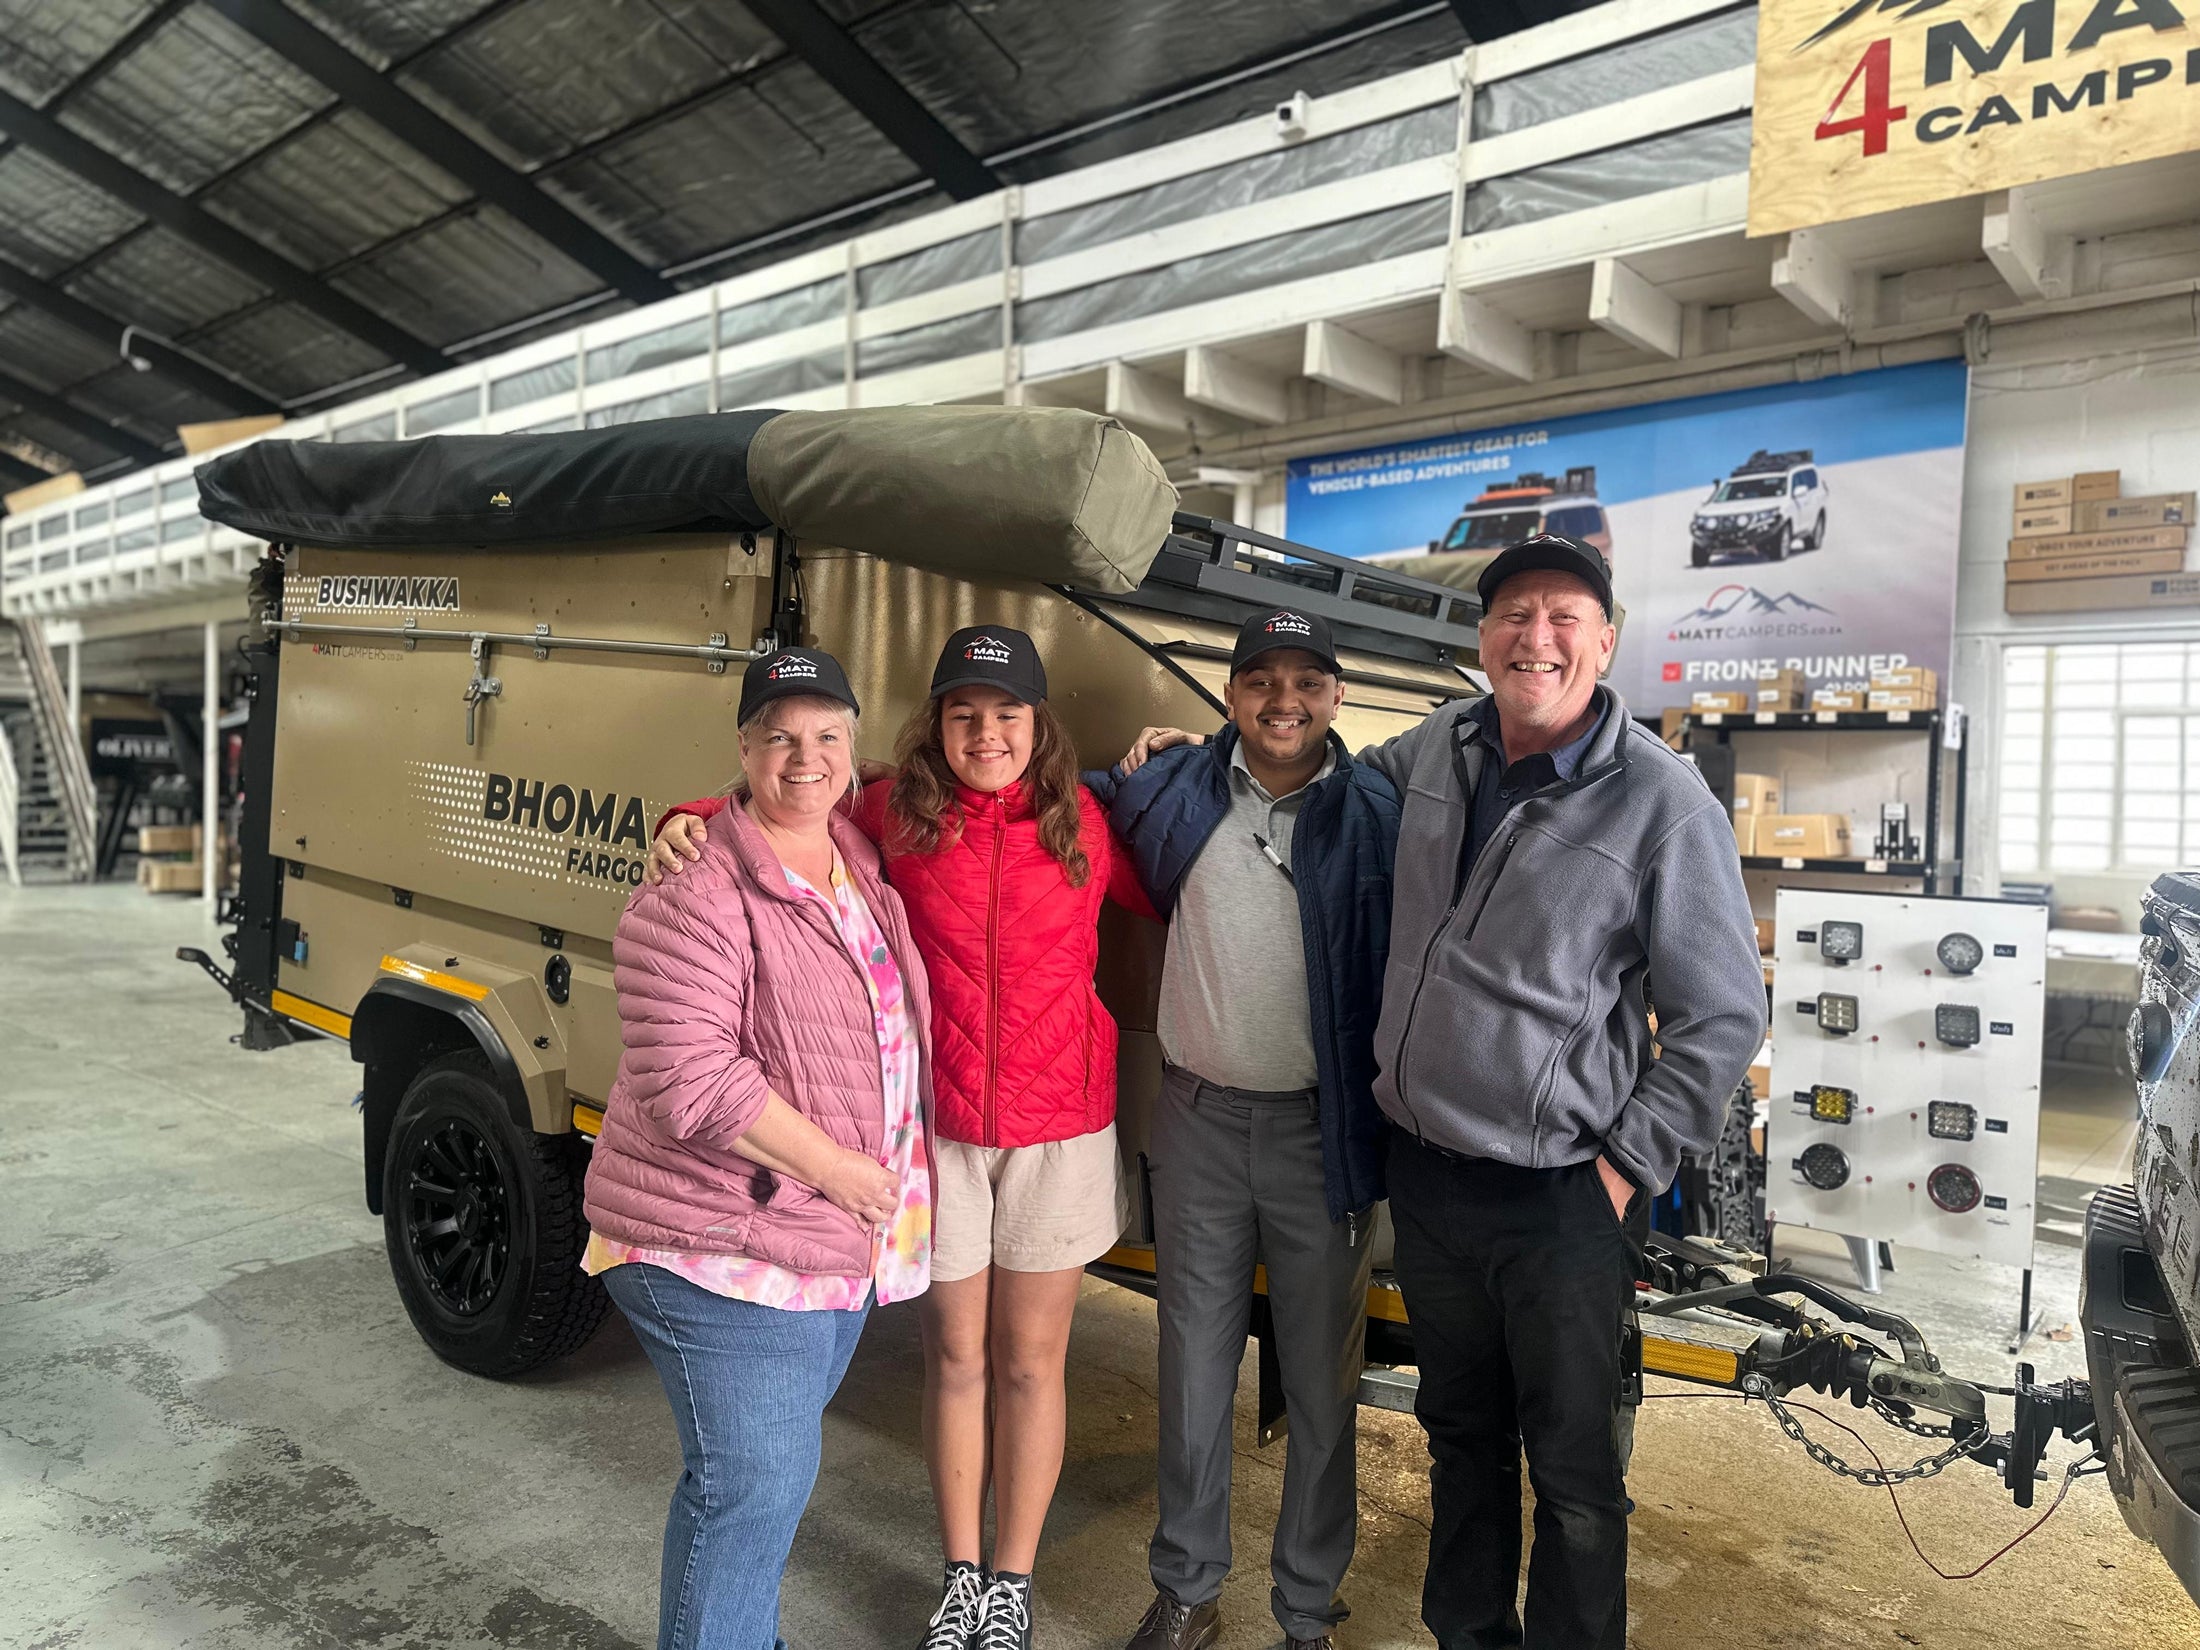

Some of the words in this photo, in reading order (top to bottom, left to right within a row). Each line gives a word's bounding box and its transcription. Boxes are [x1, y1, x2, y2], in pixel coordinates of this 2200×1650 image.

[1814, 38, 1907, 158] 4
[1915, 48, 2200, 143] CAMP
[1309, 461, 1333, 477] THE
[1335, 452, 1396, 473] WORLD'S
[1398, 441, 1471, 464] SMARTEST
[1472, 434, 1513, 454] GEAR
[1517, 430, 1548, 448] FOR
[1308, 468, 1413, 495] VEHICLE-BASED
[1416, 455, 1511, 481] ADVENTURES
[316, 576, 460, 611] BUSHWAKKA
[1264, 623, 1274, 632] 4
[1275, 620, 1310, 630] MATT
[768, 669, 778, 680] 4
[779, 664, 816, 674] MATT
[964, 648, 972, 660] 4
[974, 648, 1010, 658] MATT
[484, 773, 650, 851] BHOMA
[565, 847, 646, 887] FARGO
